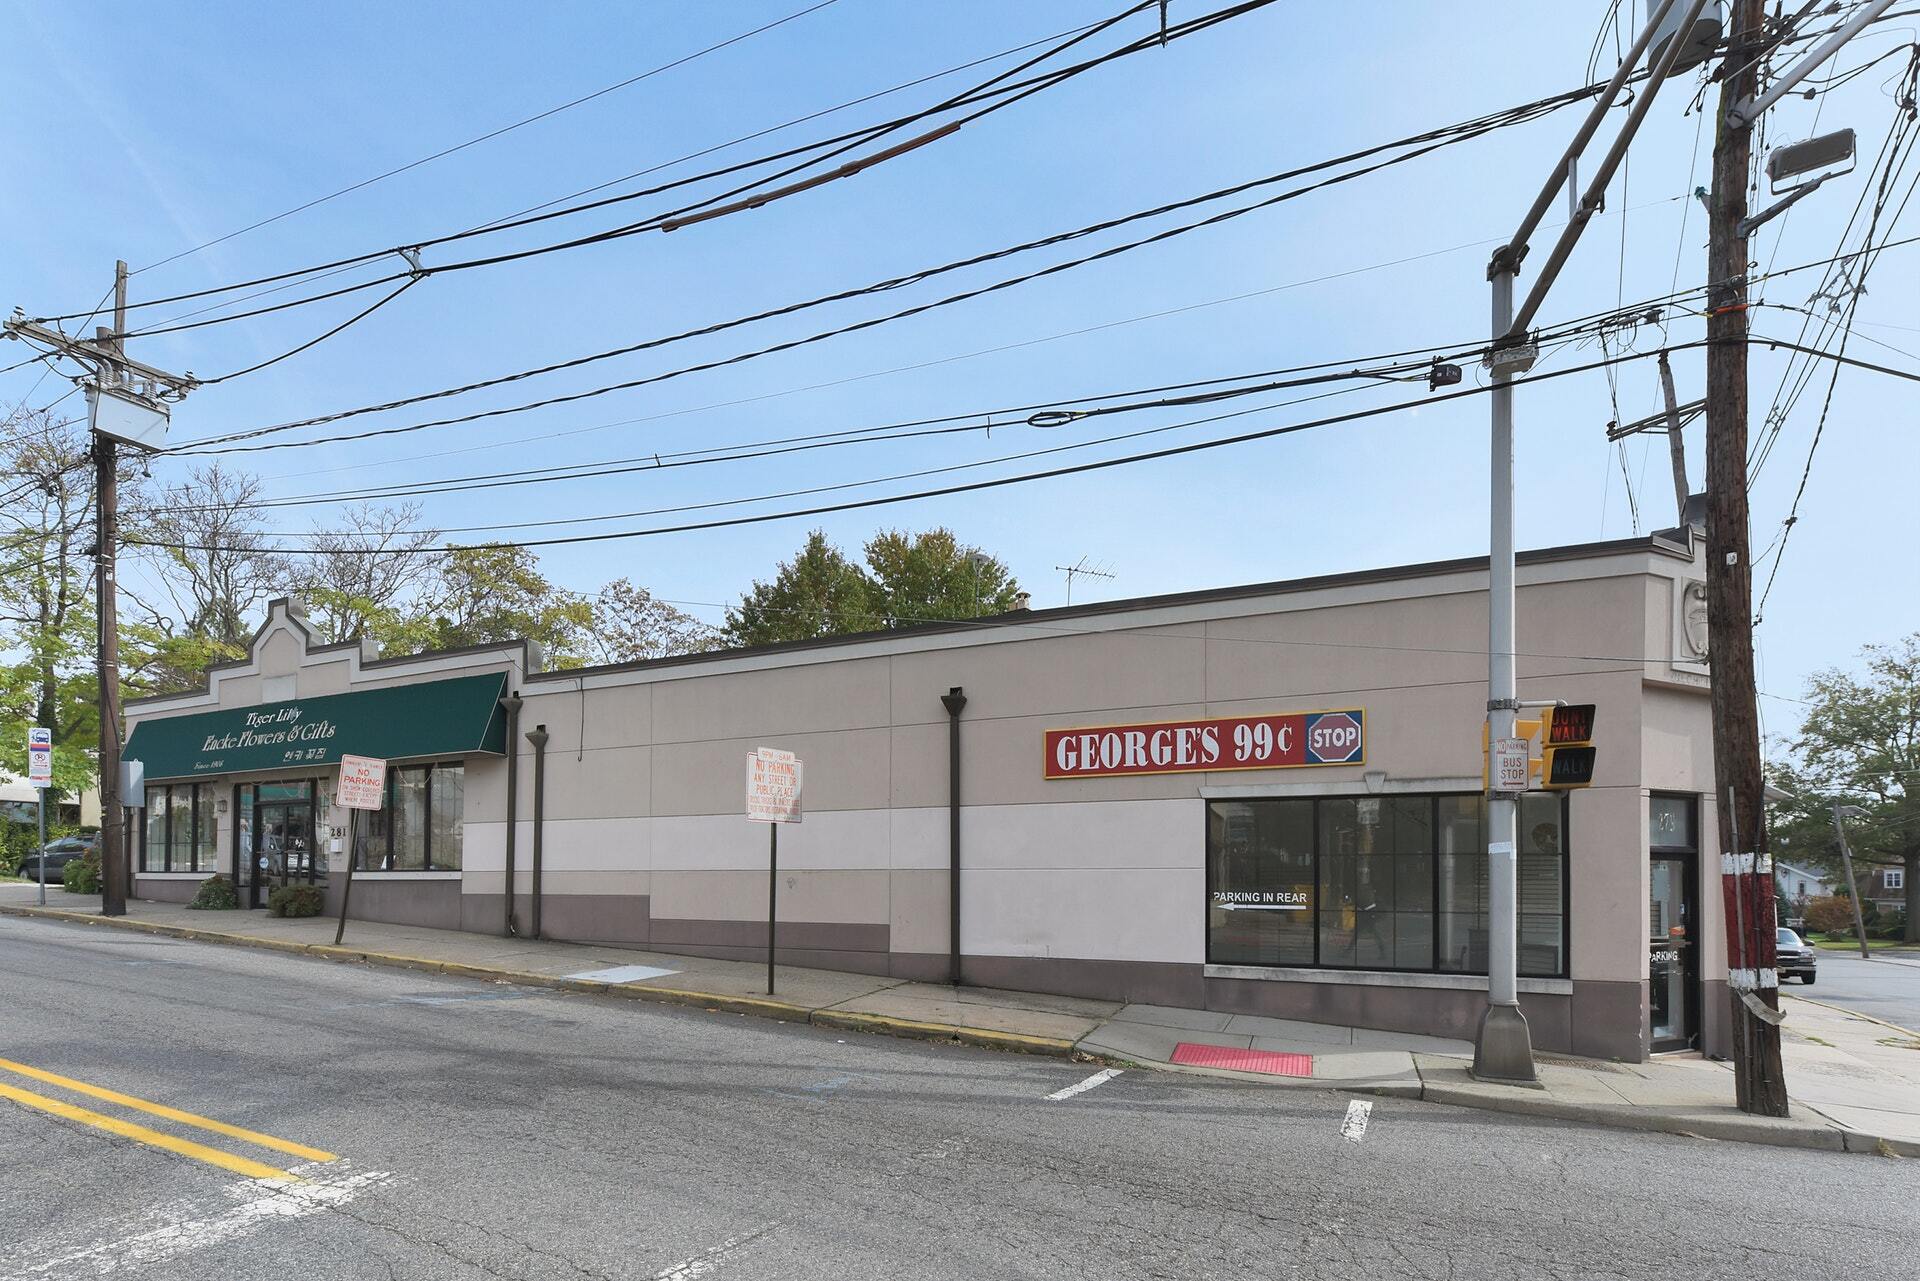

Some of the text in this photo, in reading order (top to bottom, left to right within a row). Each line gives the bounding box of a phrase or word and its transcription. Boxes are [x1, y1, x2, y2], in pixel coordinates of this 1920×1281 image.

[246, 711, 276, 728] Tiger
[202, 720, 336, 751] Encke Flowers & Gifts
[1314, 727, 1356, 748] STOP
[1552, 727, 1586, 741] WALK
[1056, 726, 1220, 771] GEORGE'S
[1497, 742, 1527, 752] NO PARKING
[756, 759, 794, 775] NO PARKING
[1503, 757, 1522, 767] BUS
[357, 768, 369, 776] NO
[753, 772, 764, 782] ANY
[768, 774, 786, 785] STREET
[1501, 769, 1524, 780] STOP
[344, 775, 380, 786] PARKING
[756, 784, 792, 797] PUBLIC PLACE
[330, 827, 346, 837] 281
[1213, 892, 1307, 903] PARKING IN REAR
